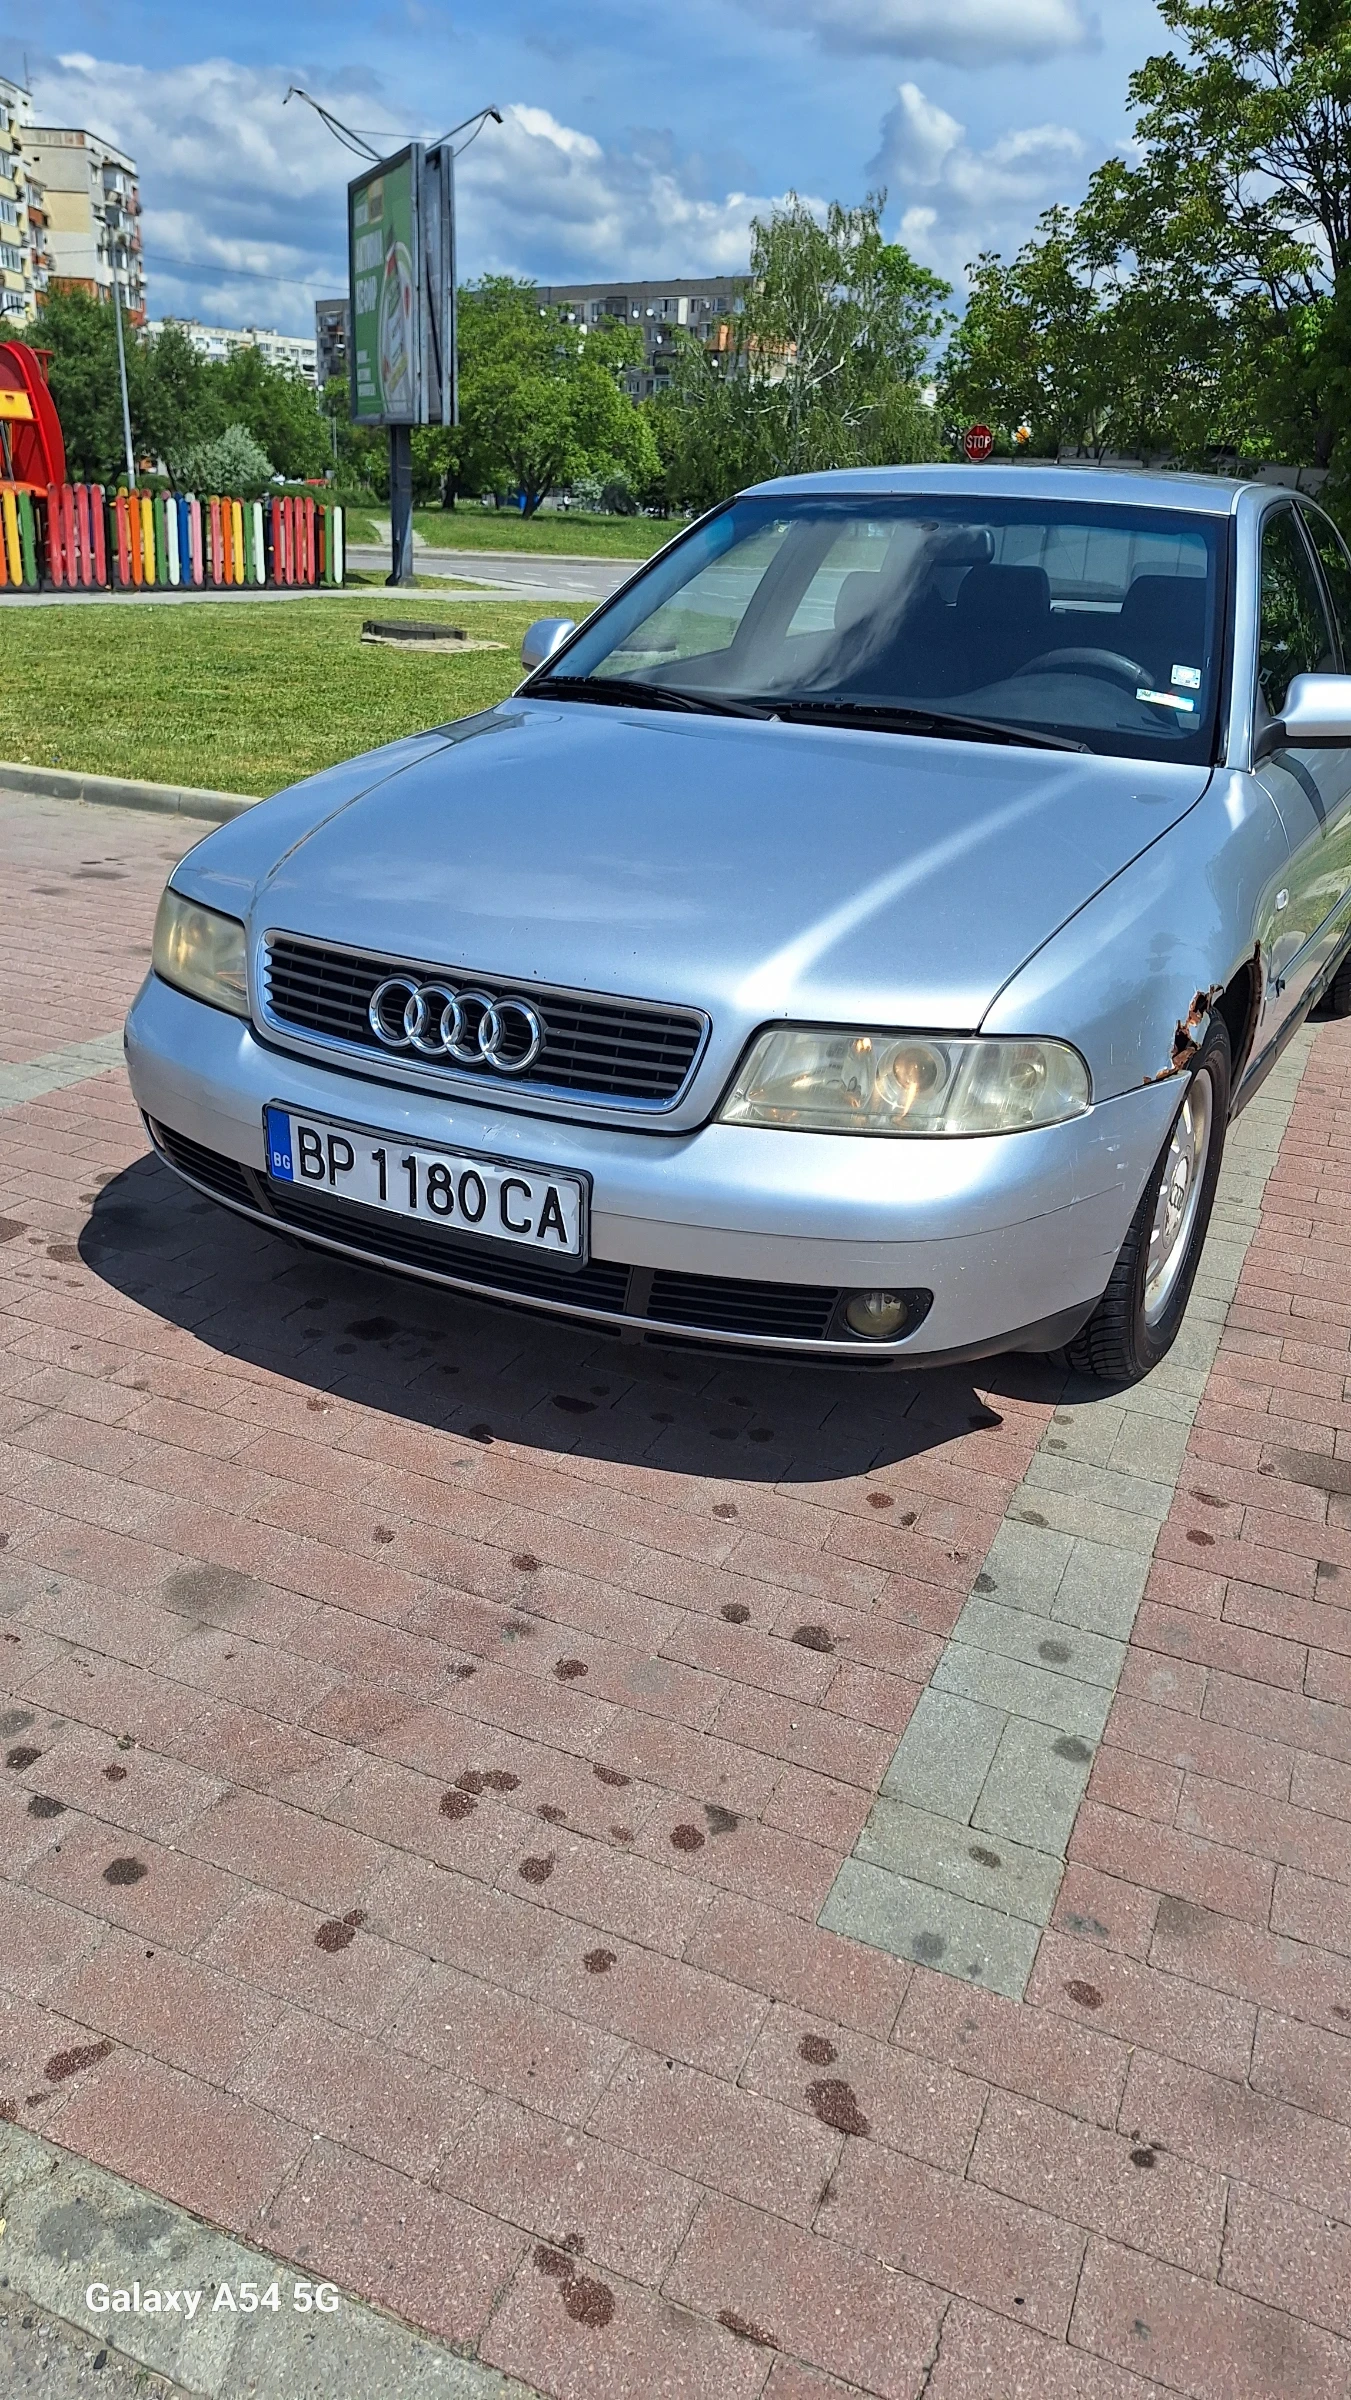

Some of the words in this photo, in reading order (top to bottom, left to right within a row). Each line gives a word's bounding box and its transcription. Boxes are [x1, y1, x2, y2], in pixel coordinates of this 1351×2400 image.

[966, 435, 992, 448] STOP
[274, 1151, 291, 1170] BG
[297, 1126, 355, 1186] BP
[372, 1148, 487, 1223] 1180
[500, 1178, 568, 1243] CA
